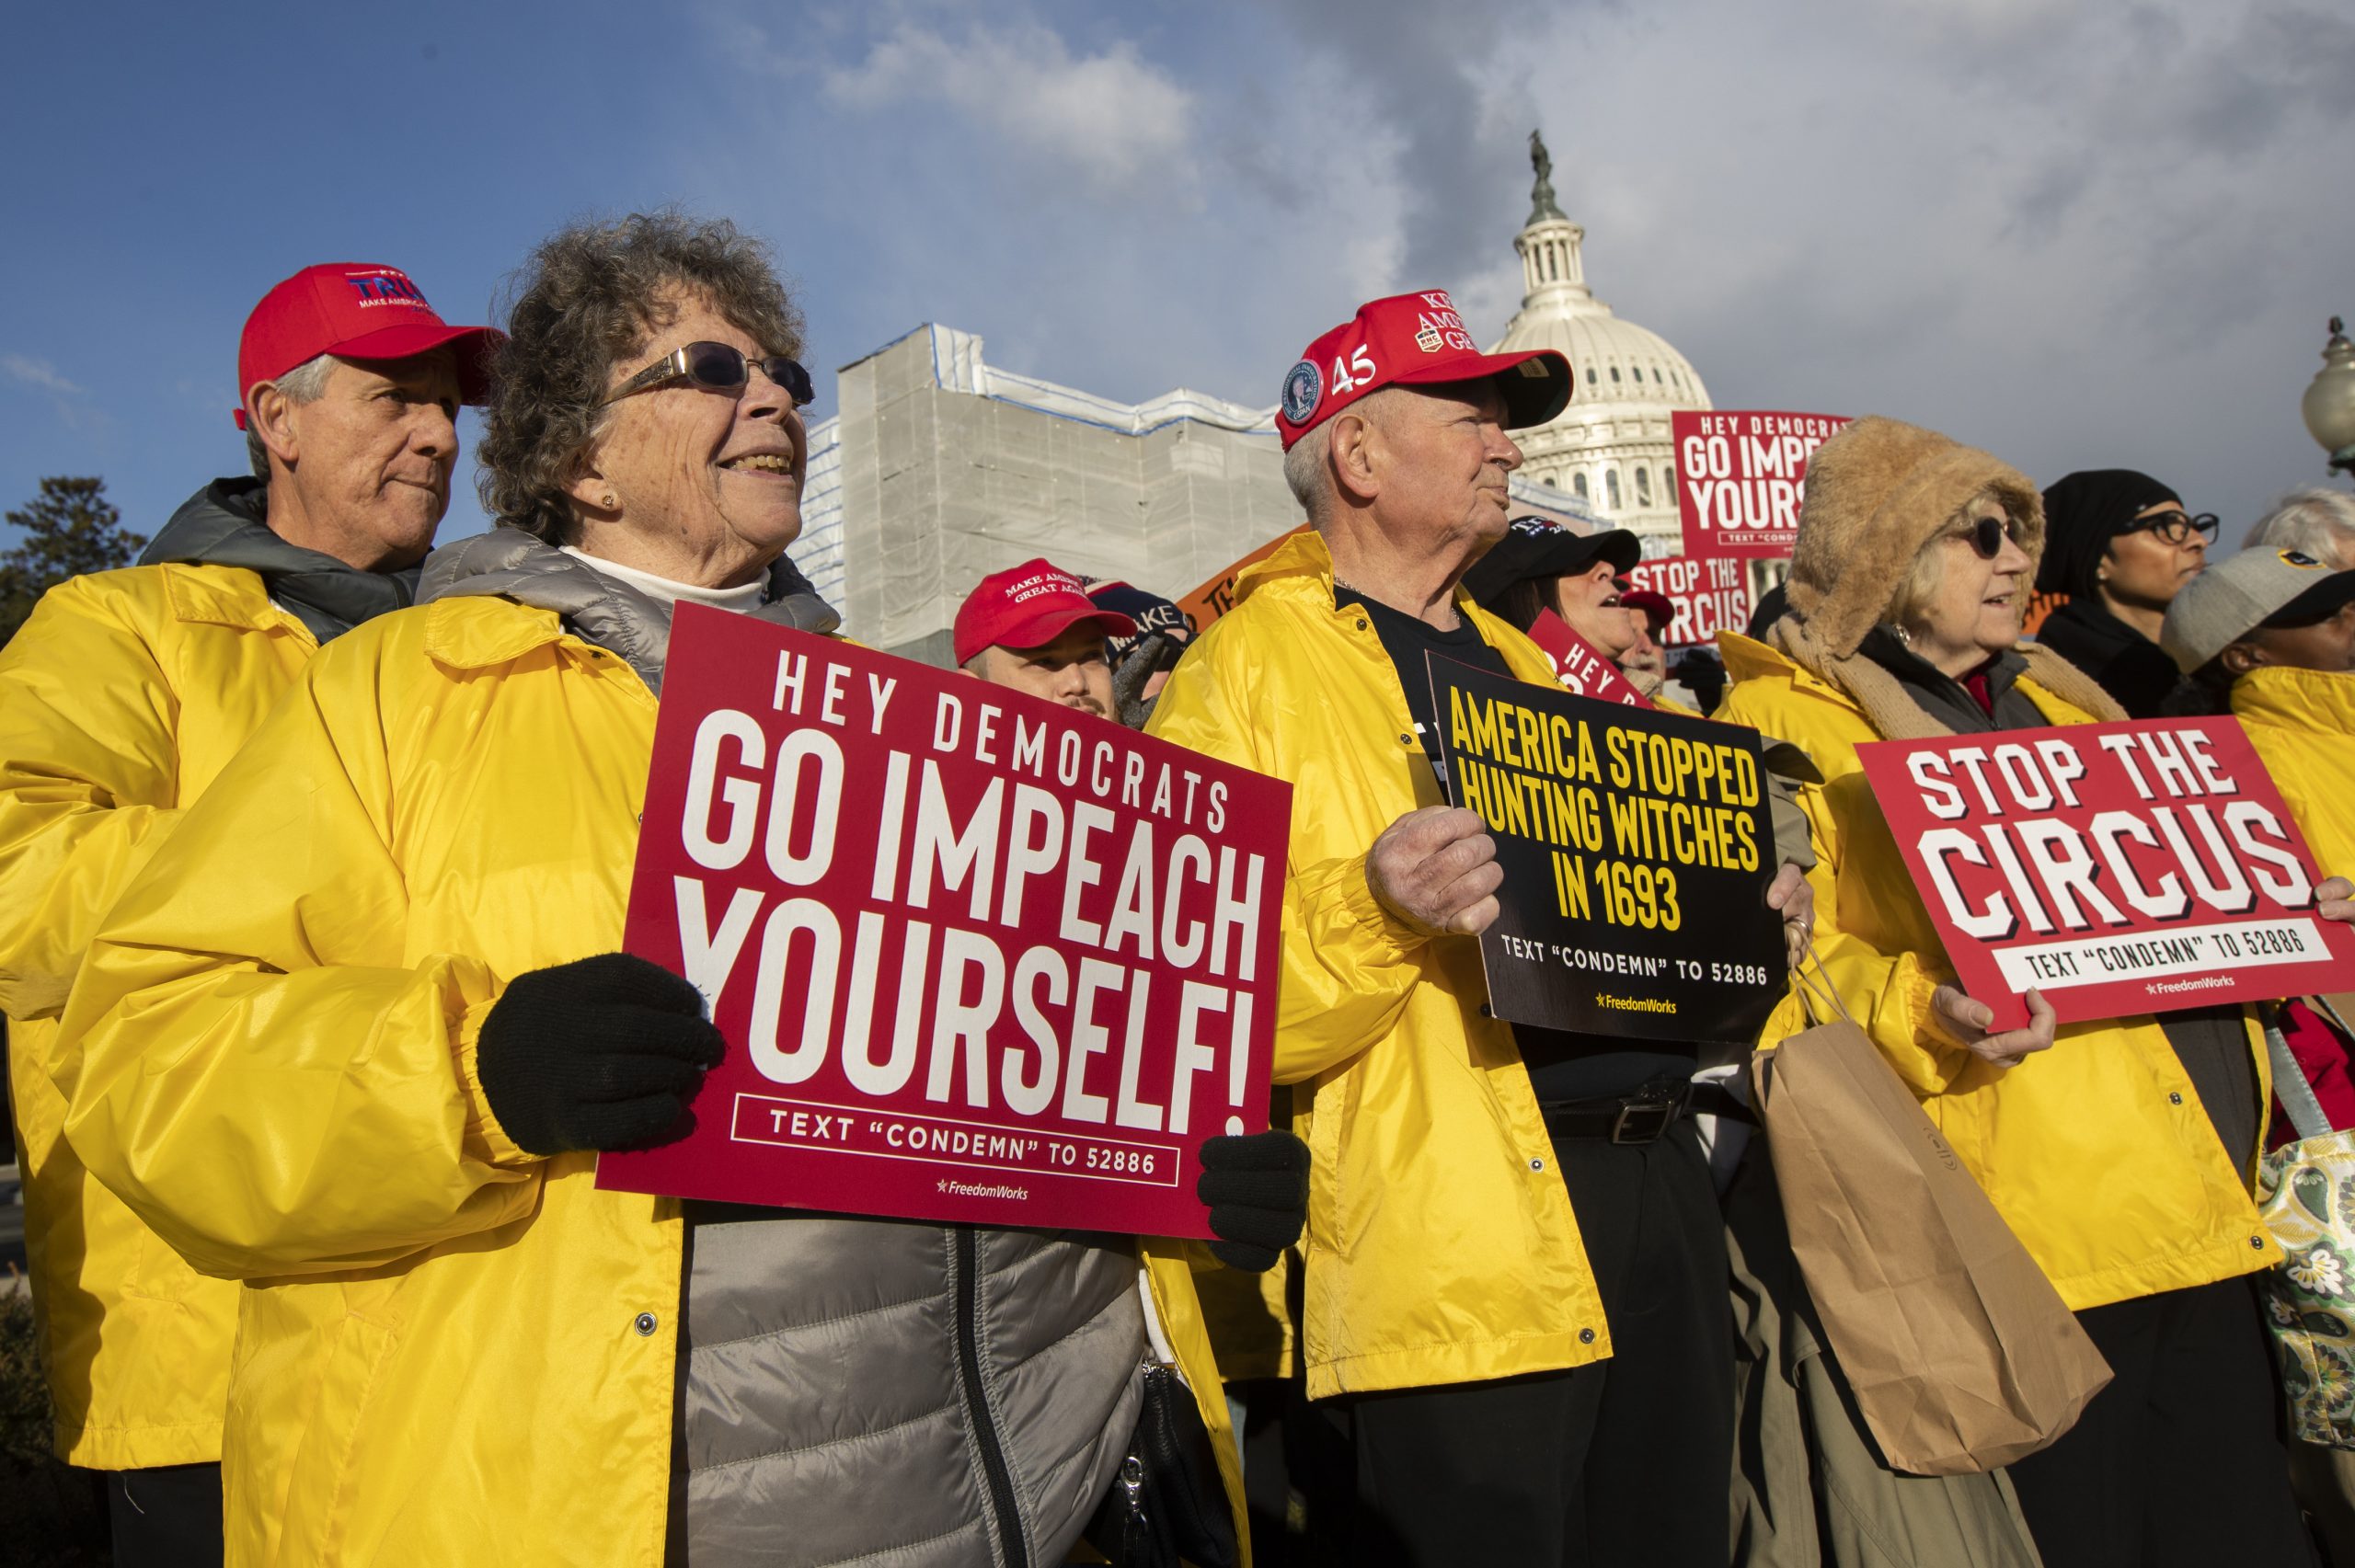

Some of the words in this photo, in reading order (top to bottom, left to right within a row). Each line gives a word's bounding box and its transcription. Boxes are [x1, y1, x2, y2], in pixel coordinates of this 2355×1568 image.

[359, 298, 387, 308] MAKE
[1331, 343, 1376, 396] 45
[1701, 417, 1739, 435] HEY
[1751, 417, 1847, 439] DEMOCRA
[1683, 435, 1731, 479] GO
[1005, 575, 1043, 598] MAKE
[1015, 583, 1057, 603] GREAT
[1631, 559, 1700, 594] STOP
[1706, 558, 1740, 589] THE
[1660, 589, 1748, 644] RCUS
[1562, 644, 1615, 694] HEY
[773, 649, 899, 734] HEY
[933, 692, 1228, 833] DEMOCRATS
[1450, 686, 1602, 784] AMERICA
[1605, 727, 1759, 807] STOPPED
[1906, 739, 2086, 819] STOP
[2098, 729, 2239, 800] THE
[1458, 757, 1603, 852] HUNTING
[1607, 793, 1759, 872] WITCHES
[682, 709, 844, 886] GO
[871, 751, 1264, 981] IMPEACH
[1552, 852, 1591, 921] IN
[1595, 860, 1681, 932] 1693
[1917, 800, 2317, 942] CIRCUS
[1501, 934, 1544, 962] TEXT
[1552, 945, 1667, 977] “CONDEMN”
[1676, 960, 1702, 980] TO
[1712, 963, 1766, 985] 52886
[2025, 952, 2079, 979] TEXT
[2084, 936, 2203, 972] “CONDEMN”
[2211, 933, 2240, 958] TO
[2247, 928, 2305, 954] 52886
[674, 876, 1253, 1138] YOURSELF!
[1606, 995, 1676, 1013] FreedomWorks
[2156, 975, 2234, 994] FreedomWorks
[771, 1109, 853, 1140] TEXT
[870, 1122, 1038, 1161] “CONDEMN”
[1050, 1143, 1076, 1166] TO
[1086, 1147, 1155, 1174] 52886
[949, 1181, 1028, 1200] FreedomWorks
